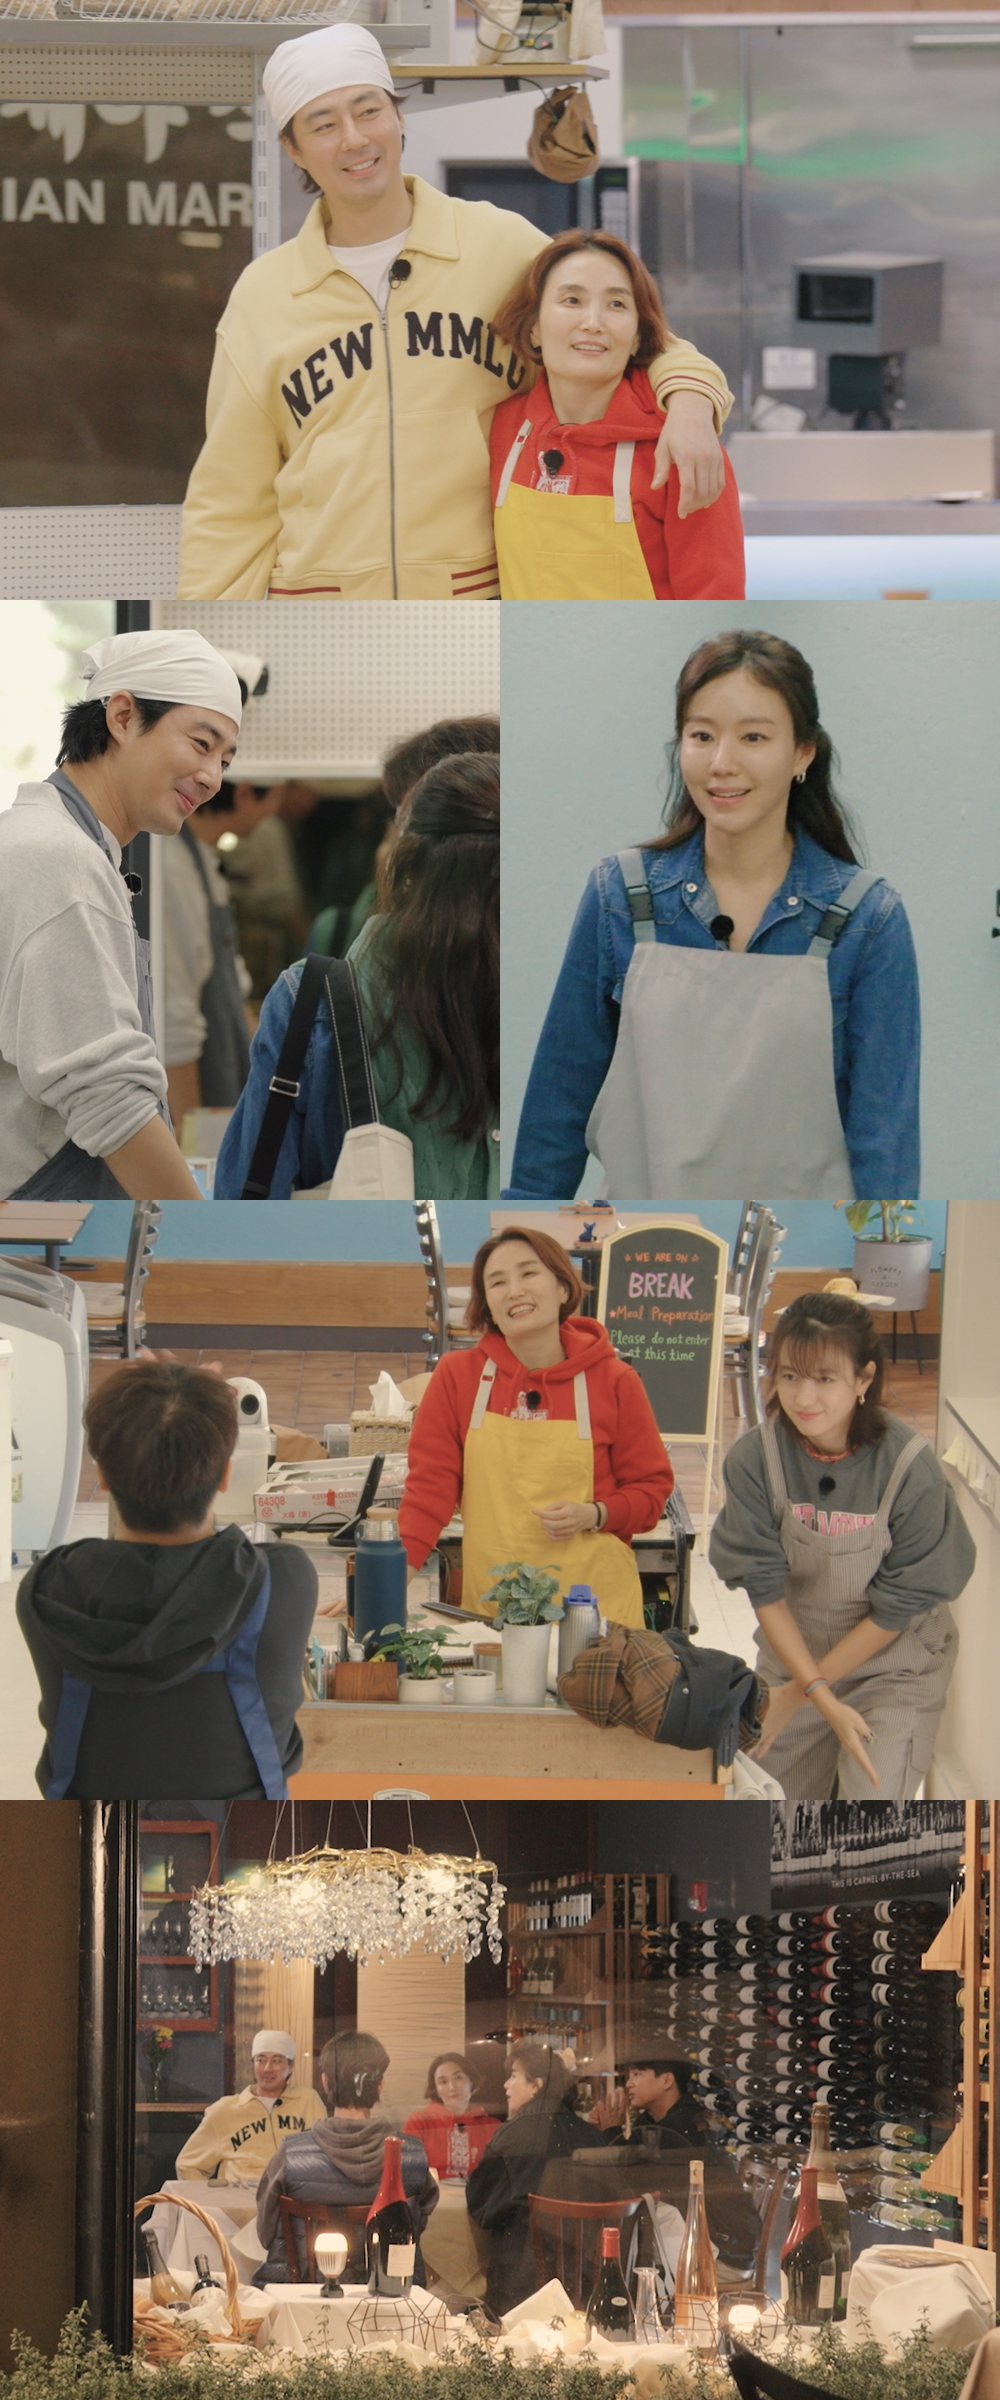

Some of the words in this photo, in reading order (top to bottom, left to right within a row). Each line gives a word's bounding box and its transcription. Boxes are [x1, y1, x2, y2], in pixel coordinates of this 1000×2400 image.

[2, 176, 105, 225] IAN
[127, 180, 253, 227] MAR
[281, 322, 373, 430] NEW
[635, 1252, 650, 1262] WE
[655, 1252, 671, 1262] ARE
[675, 1253, 688, 1263] ON
[628, 1271, 695, 1299] BREAK
[616, 1304, 645, 1320] Meal
[651, 1305, 714, 1325] Preparation
[610, 1329, 646, 1345] Please
[651, 1331, 663, 1344] do
[666, 1333, 684, 1345] not
[685, 1333, 710, 1345] enter
[628, 1346, 641, 1358] at
[644, 1346, 667, 1360] this
[669, 1348, 695, 1361] time
[258, 1496, 285, 1506] 64308
[333, 1491, 358, 1499] ROZEN
[831, 1879, 845, 1888] THIS
[846, 1877, 853, 1887] IS
[853, 1869, 920, 1886] CARMEL-BY-THE-SEA
[230, 2117, 267, 2153] NEW
